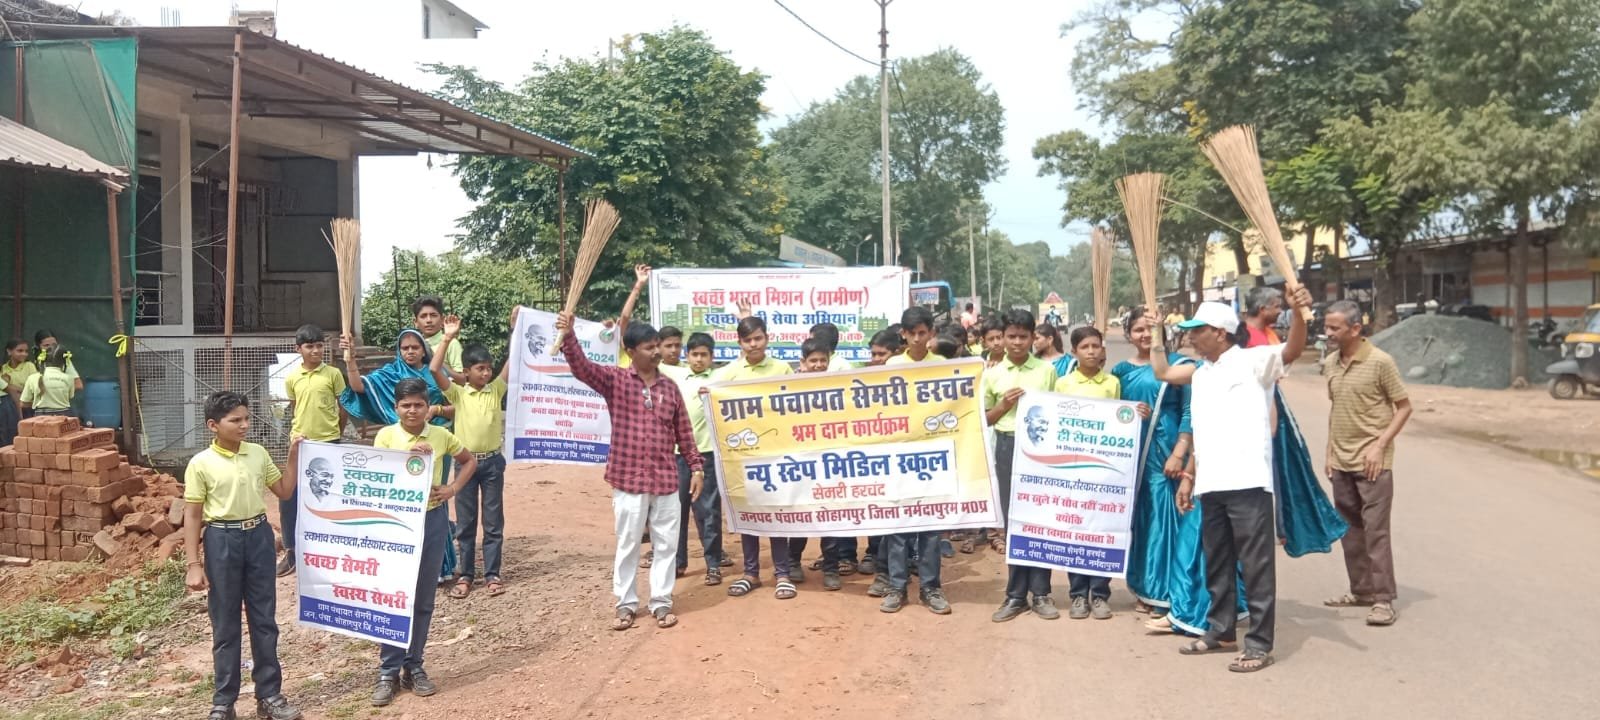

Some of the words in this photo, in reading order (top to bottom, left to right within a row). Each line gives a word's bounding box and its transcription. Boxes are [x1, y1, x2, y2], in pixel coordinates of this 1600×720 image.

[766, 286, 804, 306] मिशन
[810, 286, 869, 310] (ग्रामीण)
[772, 310, 797, 325] सेवा
[802, 310, 857, 325] अभियान
[588, 351, 615, 363] 2024
[718, 396, 763, 422] ग्राम
[768, 386, 845, 416] पंचायत
[850, 376, 909, 409] सेमरी
[914, 369, 976, 403] हरचंद
[792, 424, 816, 442] श्रम
[820, 421, 849, 440] दान
[851, 412, 909, 437] कार्यक्रम
[1058, 416, 1106, 431] स्वच्छता
[1057, 428, 1070, 442] ही
[1072, 430, 1098, 445] सेवा
[1100, 434, 1135, 449] 2024
[344, 468, 395, 484] स्वच्छता
[745, 464, 777, 492] न्यू
[776, 456, 817, 483] स्टेप
[822, 450, 891, 480] मिडिल
[896, 450, 949, 481] स्कूल
[1020, 474, 1043, 485] स्वभाव
[342, 481, 358, 496] ही
[359, 484, 387, 499] सेवा
[388, 488, 424, 503] 2024
[812, 481, 847, 500] सेमरी
[850, 481, 886, 499] हरचंद
[1017, 492, 1030, 502] हम
[738, 511, 773, 523] जनपद
[775, 508, 813, 524] पंचायत
[815, 506, 866, 525] सोहागपुर
[868, 504, 900, 520] जिला
[903, 500, 958, 519] नर्मदापुरम
[304, 531, 329, 543] स्वभाव
[386, 541, 416, 555] स्वच्छता
[303, 552, 340, 570] स्वच्छ
[341, 554, 380, 577] सेमरी
[370, 588, 408, 610] सेमरी
